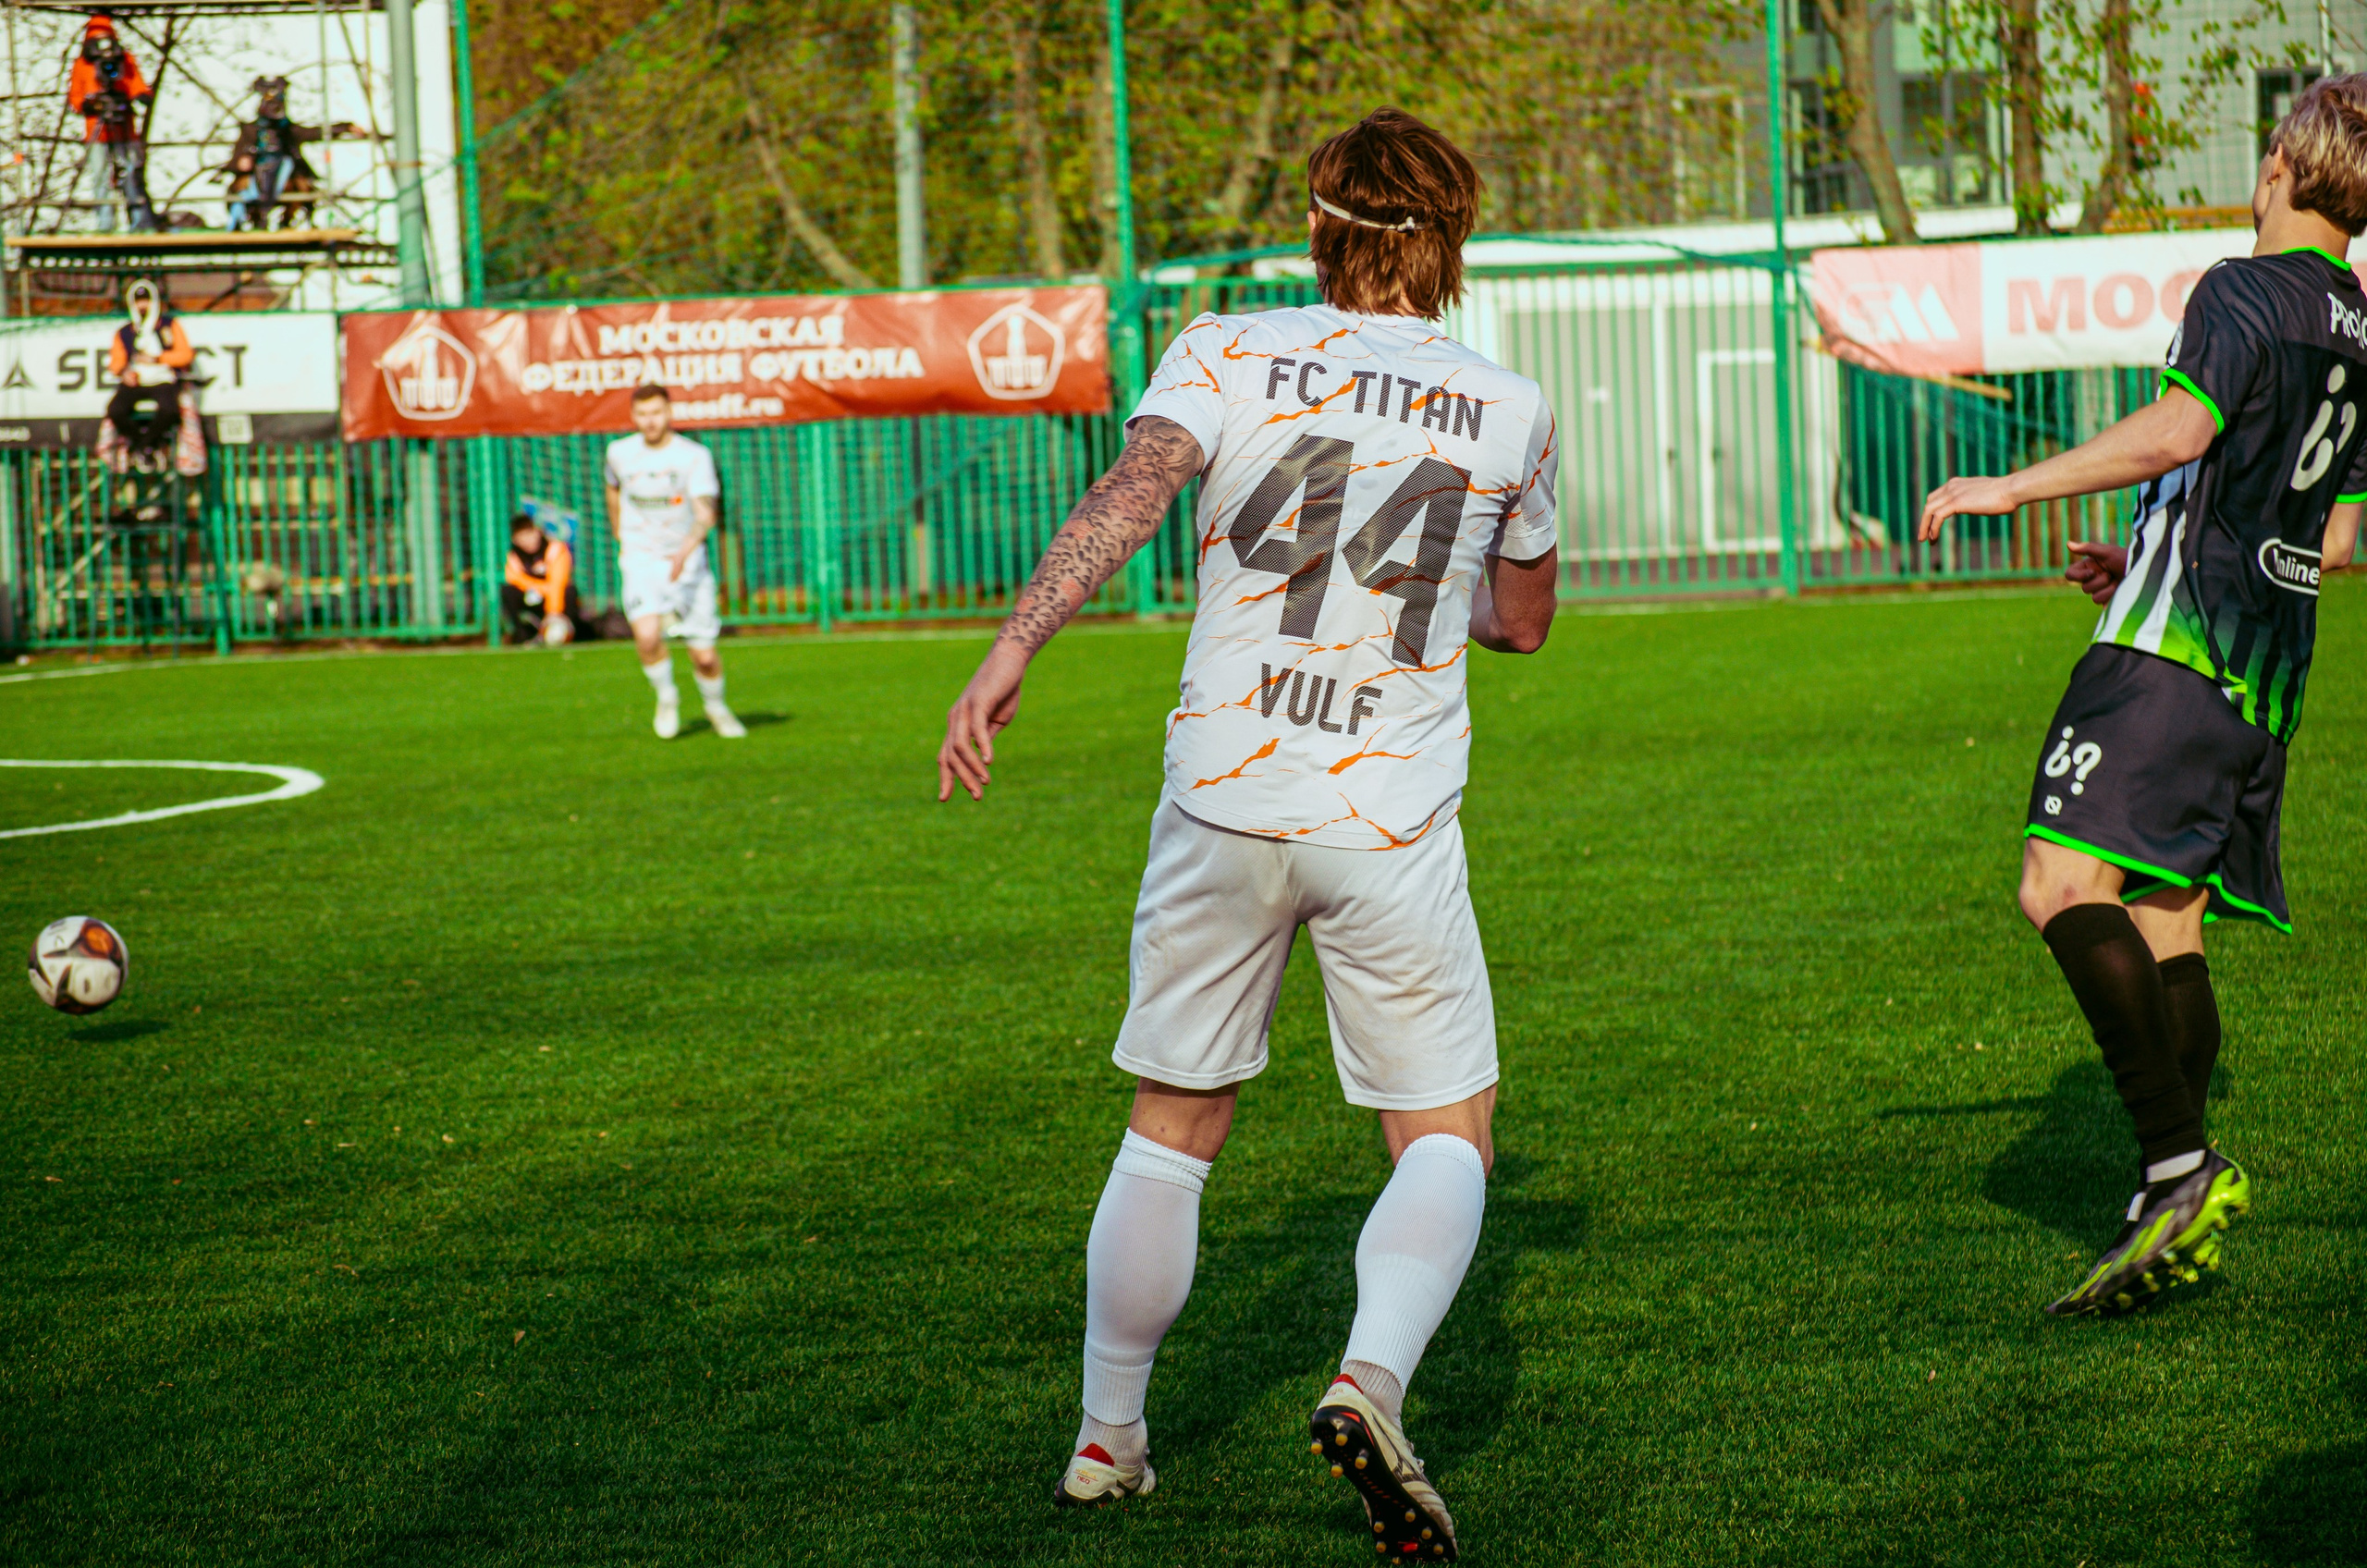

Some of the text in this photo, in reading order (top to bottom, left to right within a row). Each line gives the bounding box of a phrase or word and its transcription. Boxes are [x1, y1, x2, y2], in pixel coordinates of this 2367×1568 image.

[598, 315, 843, 355] МОСКОВСКАЯ
[57, 344, 248, 392] SECT
[522, 347, 924, 396] ФЕДЕРАЦИЯ ФУТБОЛА
[1266, 358, 1484, 442] FC TITAN
[1228, 434, 1473, 669] 44
[1261, 662, 1383, 736] VULF
